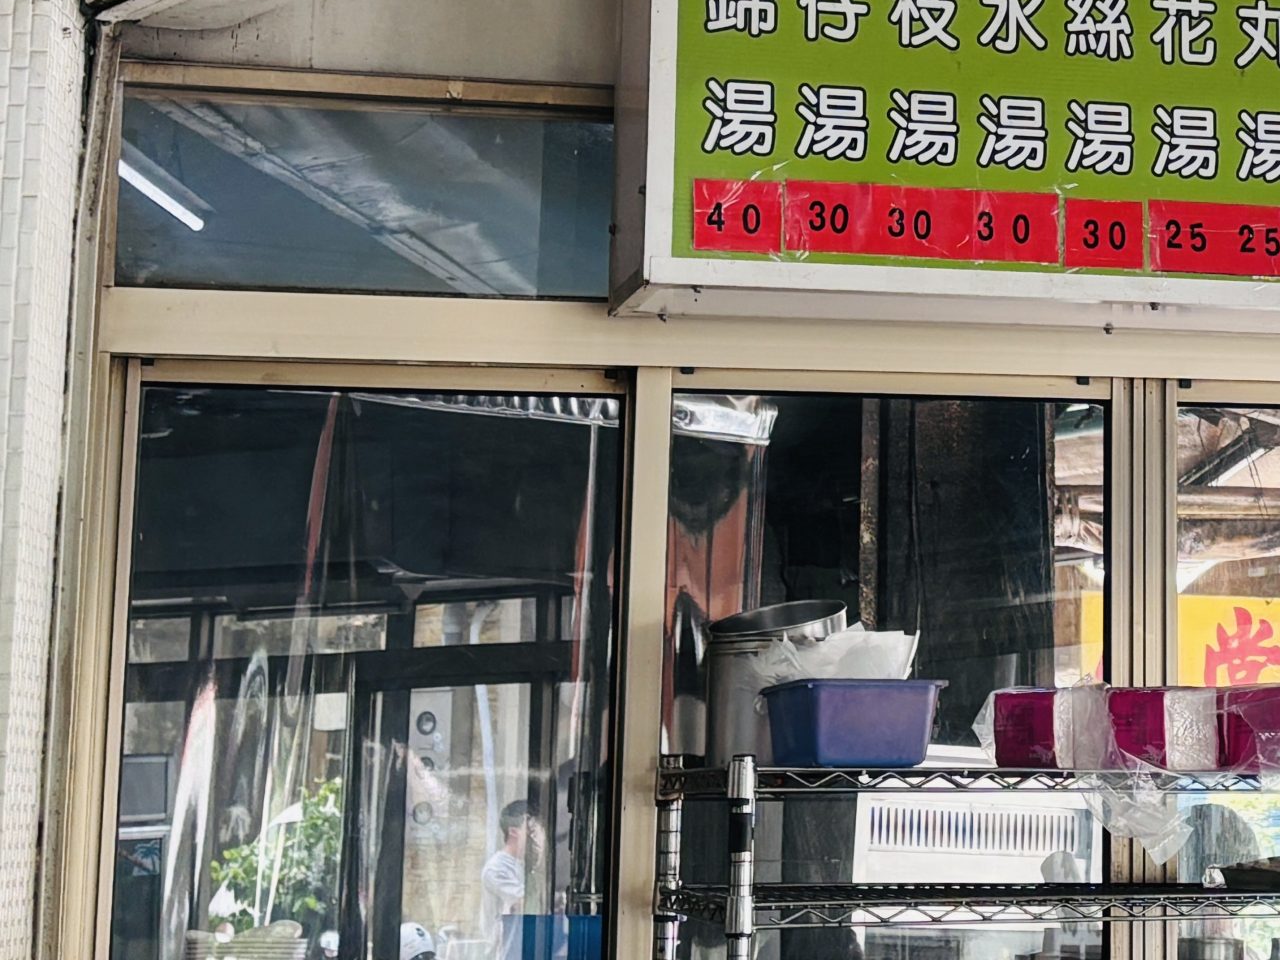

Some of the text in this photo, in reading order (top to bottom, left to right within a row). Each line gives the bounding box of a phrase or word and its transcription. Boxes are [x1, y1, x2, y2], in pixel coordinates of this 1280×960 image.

[706, 202, 761, 235] 40
[808, 200, 849, 234] 30
[887, 207, 932, 240] 30
[977, 211, 1030, 244] 30
[1083, 218, 1126, 251] 30
[1165, 219, 1207, 253] 25
[1238, 224, 1280, 257] 25
